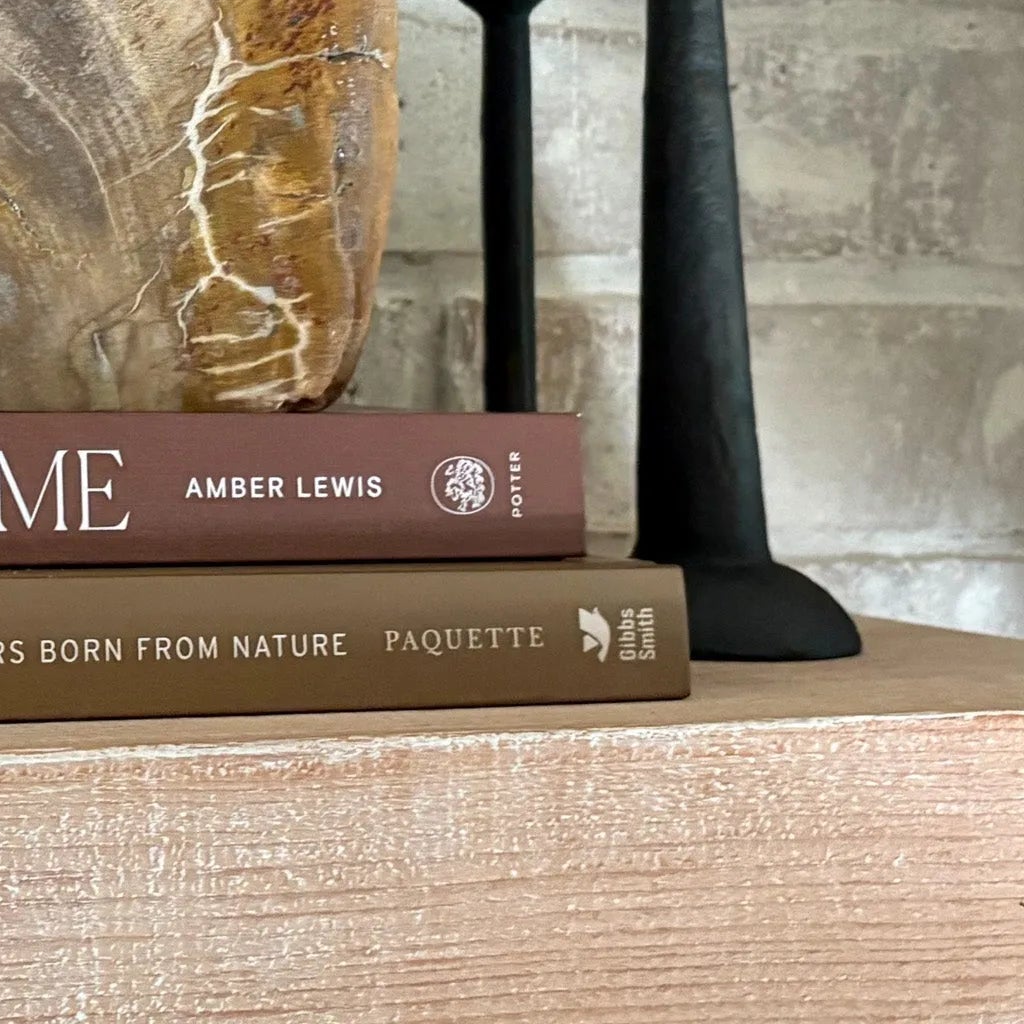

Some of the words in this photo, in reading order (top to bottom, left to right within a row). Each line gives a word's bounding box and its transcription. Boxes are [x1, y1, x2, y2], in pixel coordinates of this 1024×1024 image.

[185, 476, 284, 499] AMBER
[296, 475, 382, 498] LEWIS
[508, 451, 523, 518] POTTER
[40, 638, 122, 663] BORN
[137, 635, 218, 661] FROM
[233, 632, 347, 658] NATURE
[384, 626, 544, 657] PAQUETTE
[618, 608, 635, 660] Gibbs
[636, 608, 655, 659] Smith
